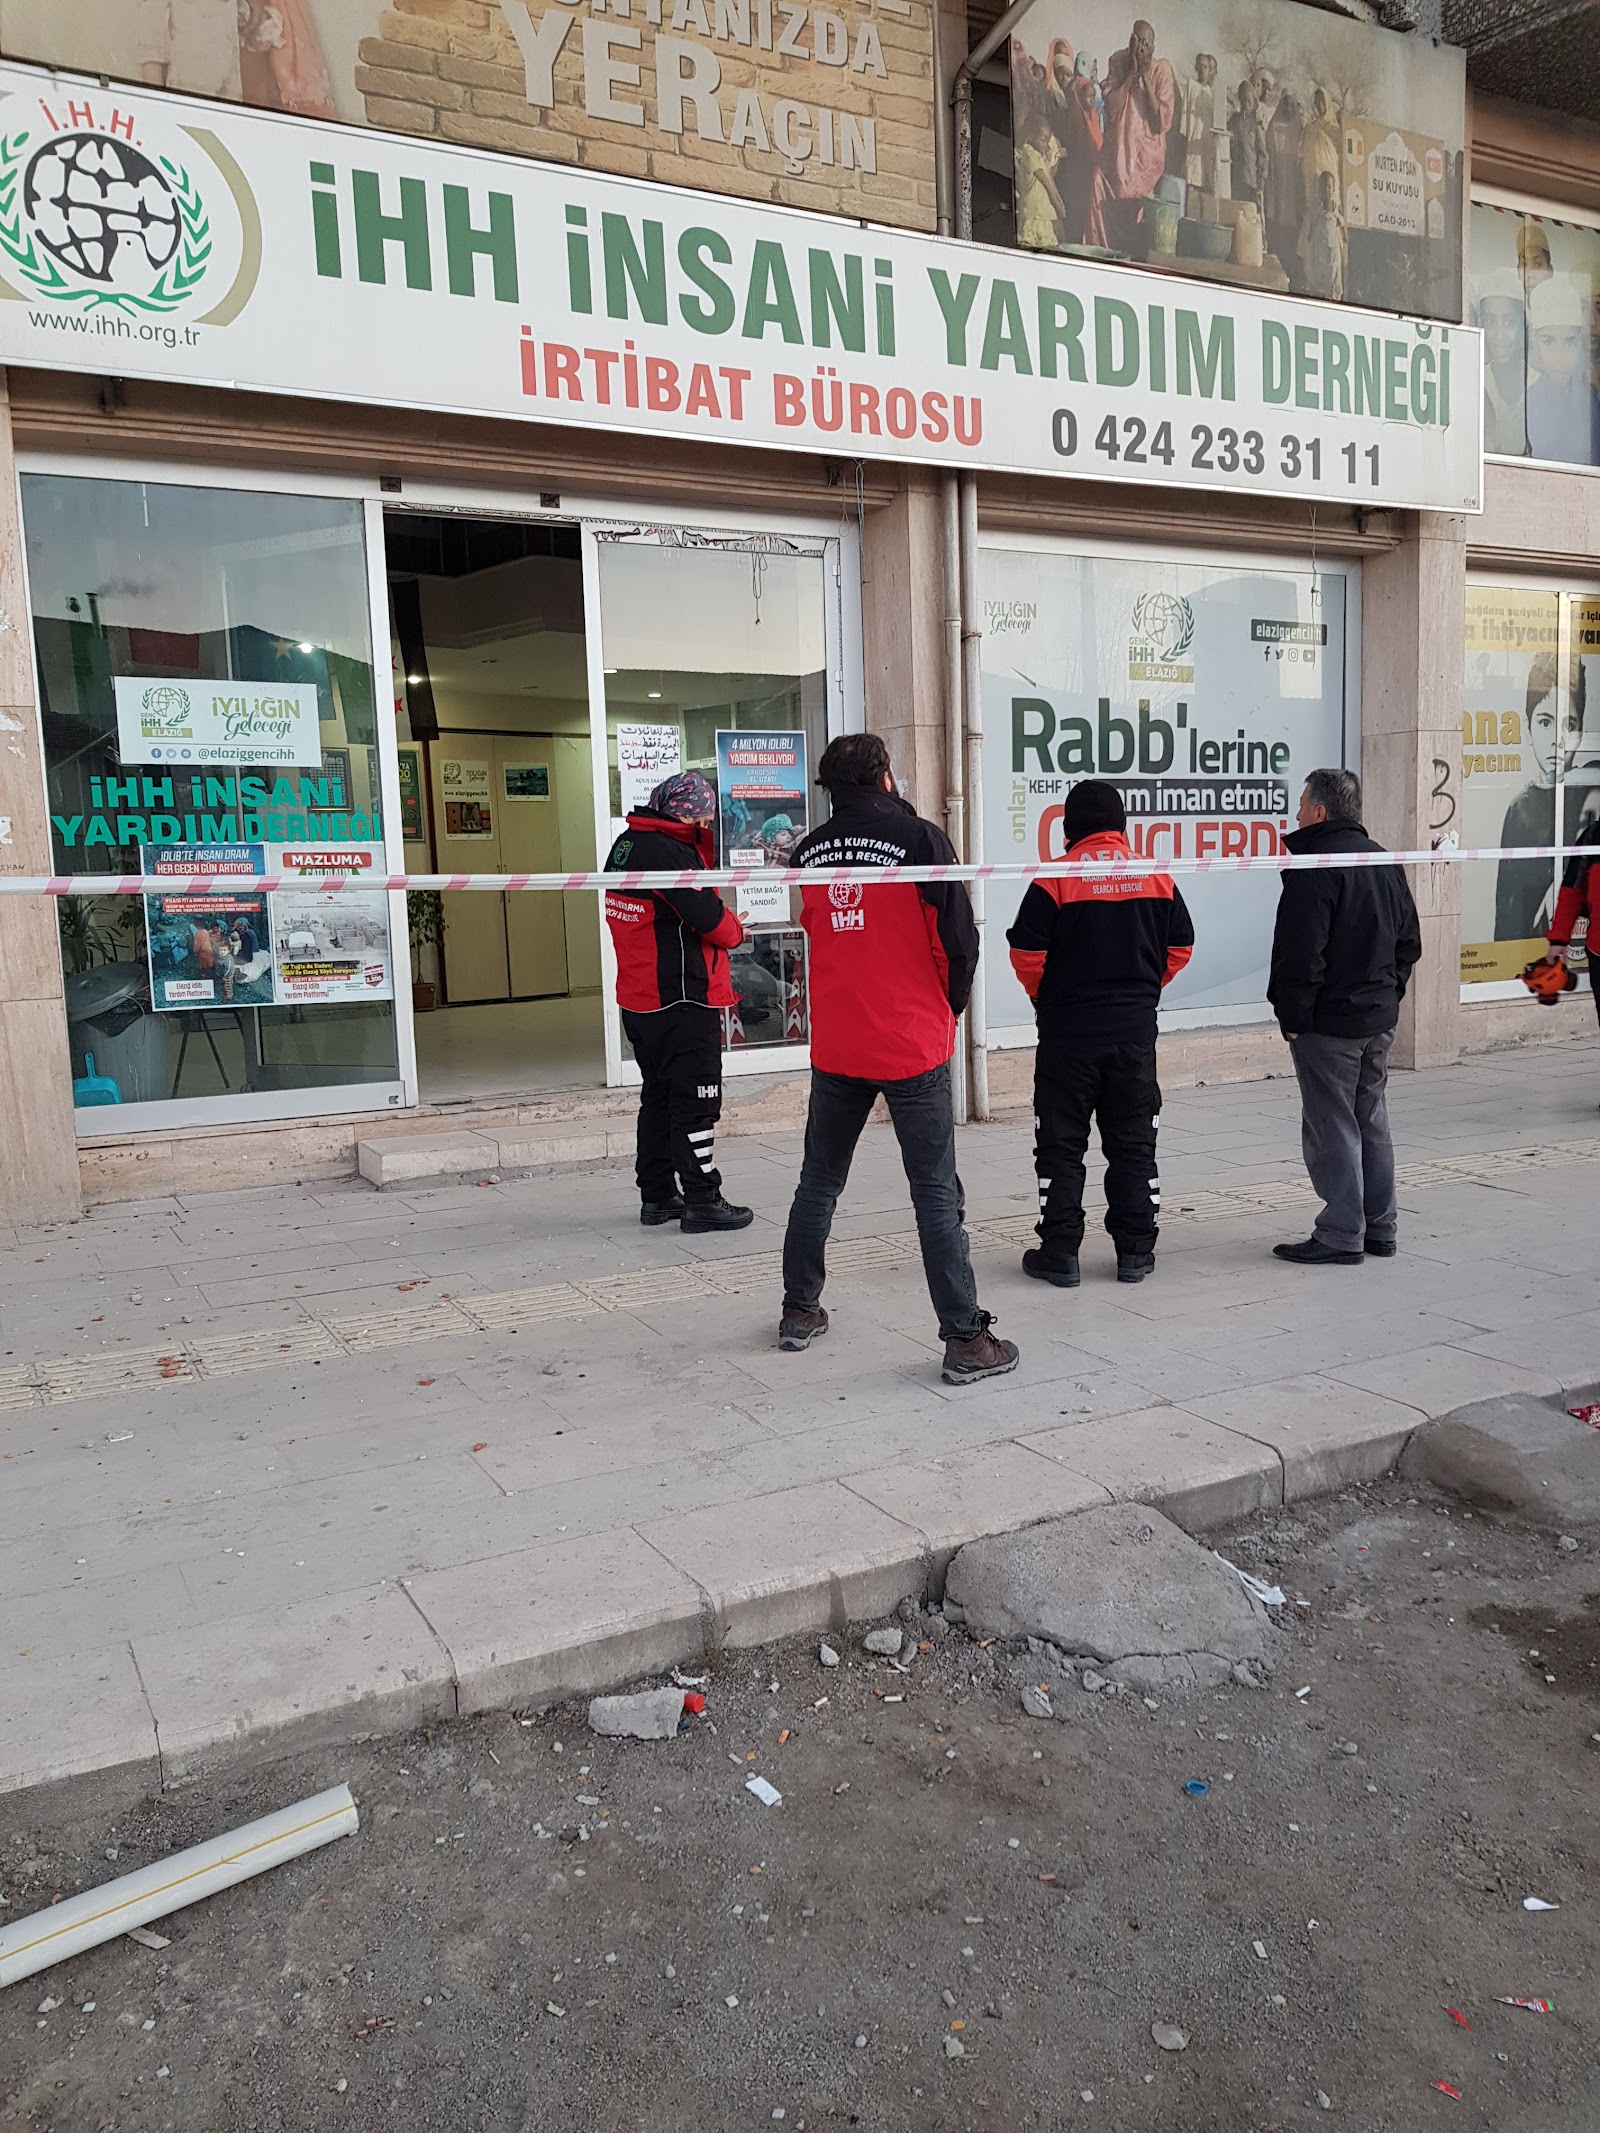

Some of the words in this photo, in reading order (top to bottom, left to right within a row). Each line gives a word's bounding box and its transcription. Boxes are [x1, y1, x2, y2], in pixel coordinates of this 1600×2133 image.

[500, 0, 727, 143] YER
[730, 88, 878, 175] AÇIN
[1372, 178, 1384, 192] SU
[1385, 180, 1419, 198] KUYUSU
[28, 310, 201, 348] www.ihh.org.tr
[926, 266, 1236, 403] YARDIM
[1261, 319, 1451, 428] DERNEĞİ
[520, 325, 752, 422] İRTİBAT
[773, 362, 983, 446] BÜROSU
[1052, 409, 1077, 456] 0
[1095, 415, 1175, 467] 424
[1190, 424, 1265, 475] 233
[1280, 434, 1321, 481] 31
[1341, 442, 1381, 487] 11
[1146, 666, 1178, 679] ELAZIĞ
[731, 738, 738, 751] 4
[198, 747, 295, 762] @elaziggencihh
[730, 753, 758, 765] YARDIM
[1029, 779, 1063, 794] KEHF
[1156, 780, 1216, 812] iman
[1221, 781, 1286, 815] etmiş
[50, 814, 238, 847] YARDIM
[243, 803, 382, 844] DERNEĞİ
[224, 849, 250, 860] DRAM
[799, 840, 831, 864] ARAMA
[833, 838, 842, 848] &
[844, 837, 907, 859] KURTARMA
[292, 854, 363, 866] MAZLUMA
[804, 851, 842, 868] SEARCH
[844, 850, 854, 861] &
[855, 851, 899, 868] RESCUE
[157, 863, 173, 874] HER
[174, 863, 200, 875] GEÇEN
[200, 862, 217, 874] GÜN
[218, 863, 254, 874] ARTIYOR!
[742, 886, 763, 895] YETİM
[764, 885, 784, 895] BAĞIŞ
[1092, 884, 1114, 895] SEARCH
[1115, 884, 1120, 894] &
[1120, 882, 1143, 893] RESCUE
[750, 897, 778, 907] SANDIĞI
